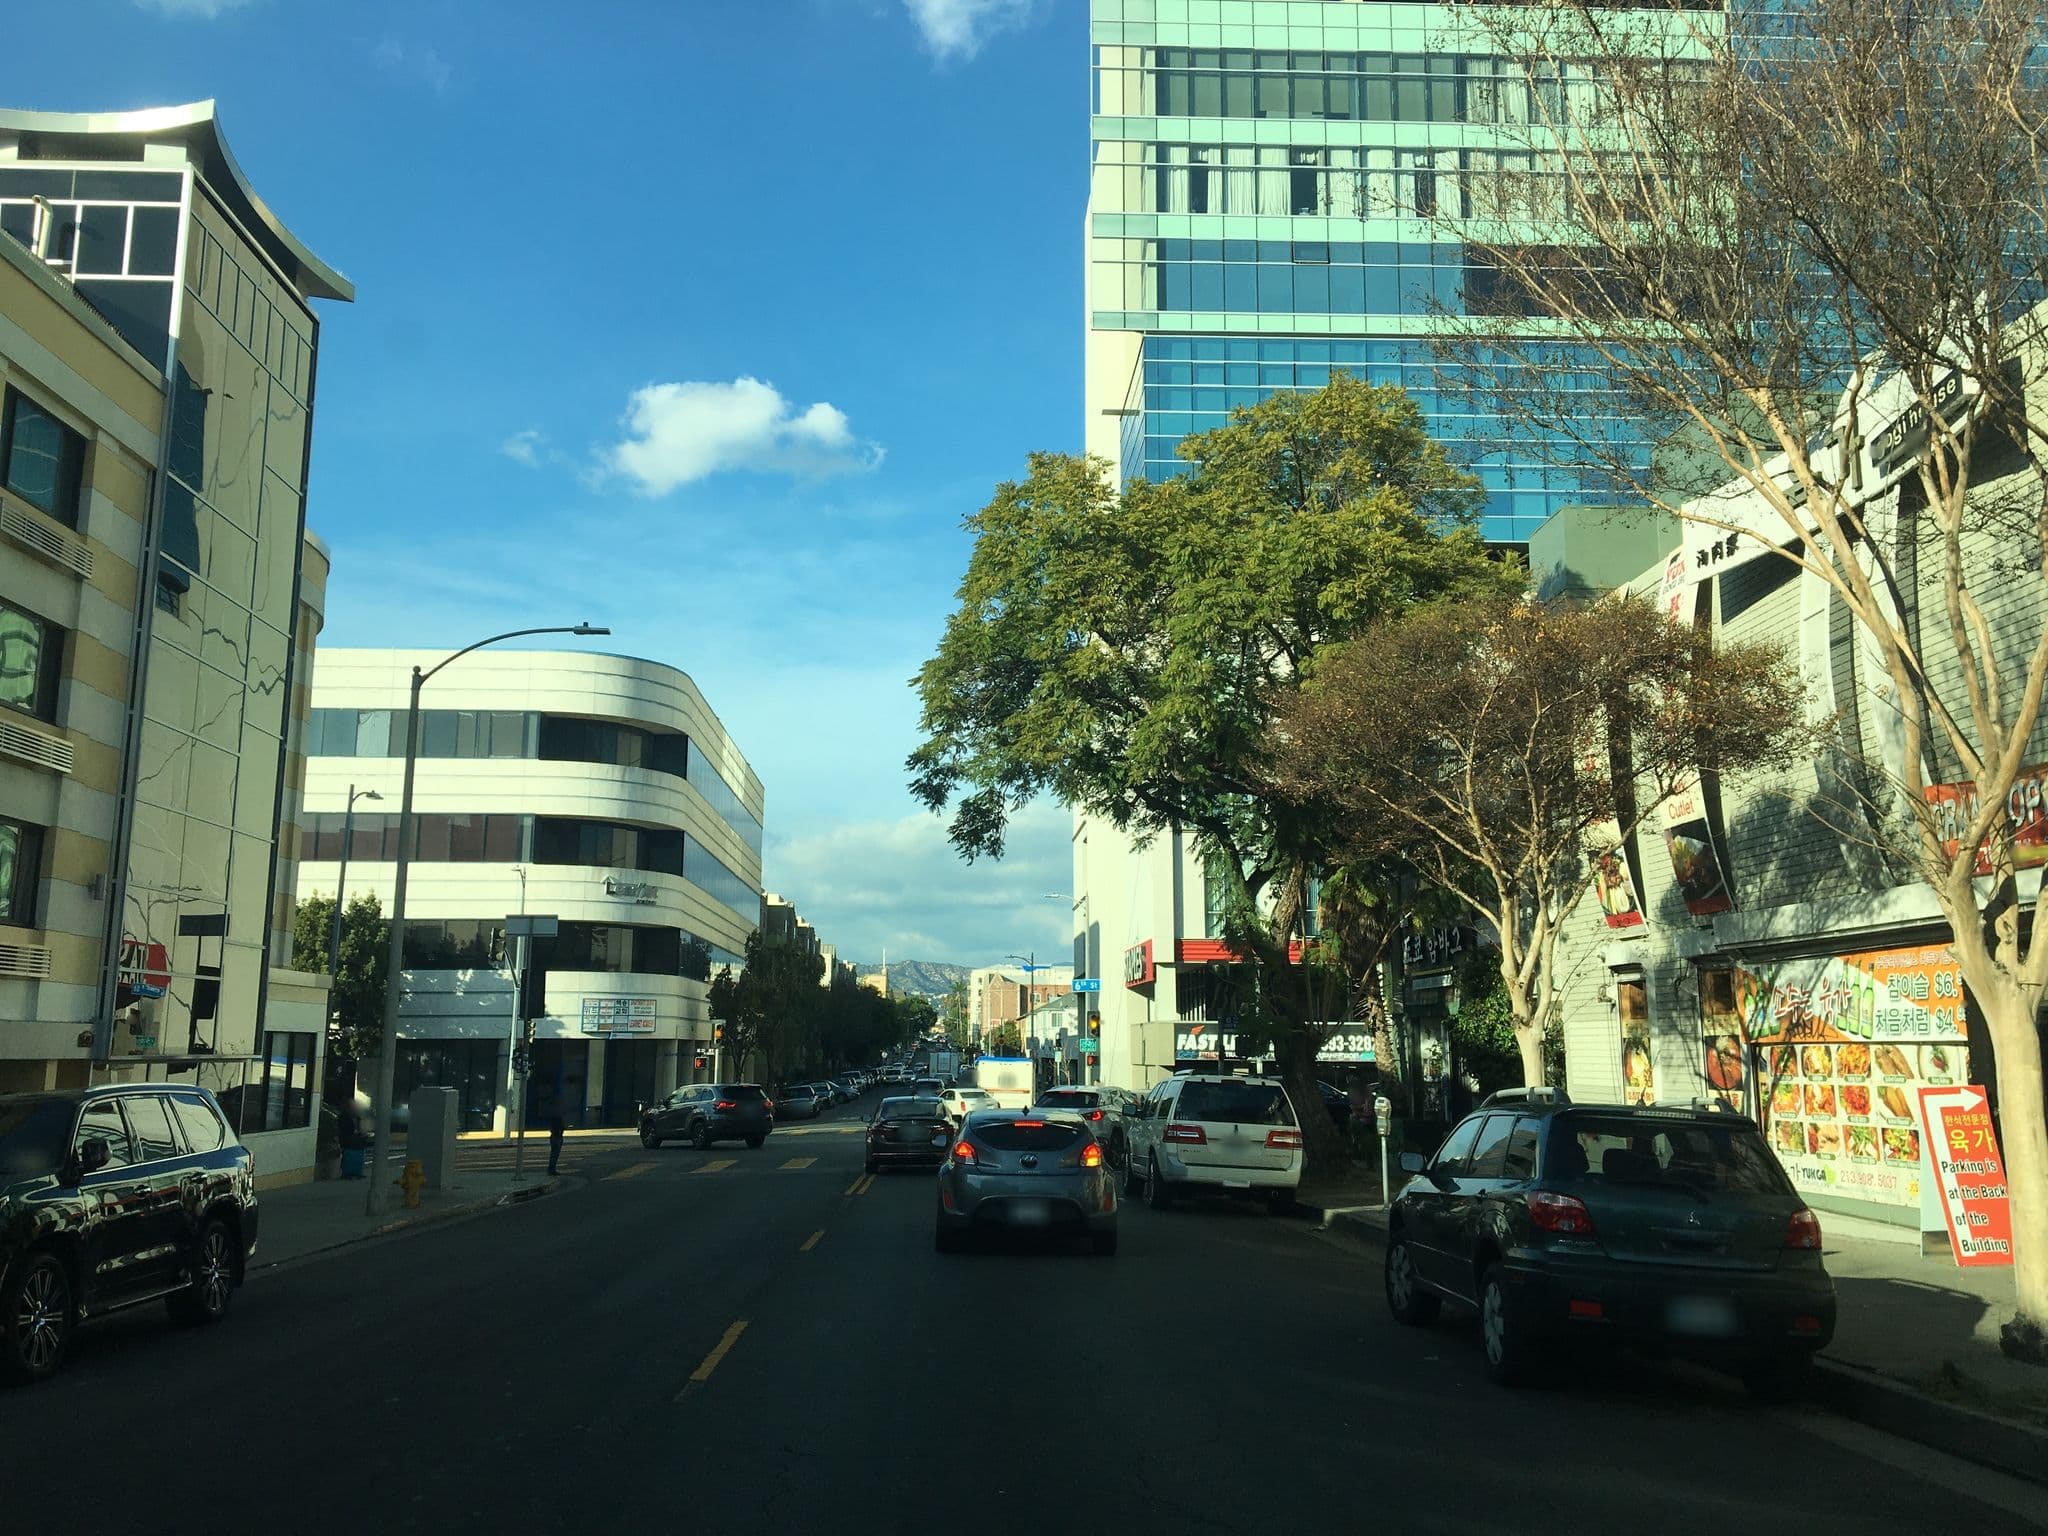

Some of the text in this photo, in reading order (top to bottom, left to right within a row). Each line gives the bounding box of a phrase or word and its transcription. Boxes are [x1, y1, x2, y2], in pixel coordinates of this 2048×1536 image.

[1668, 799, 1695, 819] Cutlet
[1090, 981, 1098, 989] St
[1887, 973, 1929, 999] 참이슬
[1875, 1008, 1930, 1034] 처음처럼
[1176, 1034, 1219, 1051] FAST
[1944, 1114, 1989, 1127] 한식전문점
[1942, 1158, 1996, 1175] Parking is
[1948, 1185, 2008, 1200] at the Back
[1955, 1212, 1988, 1226] of the
[1962, 1239, 2008, 1253] Building
